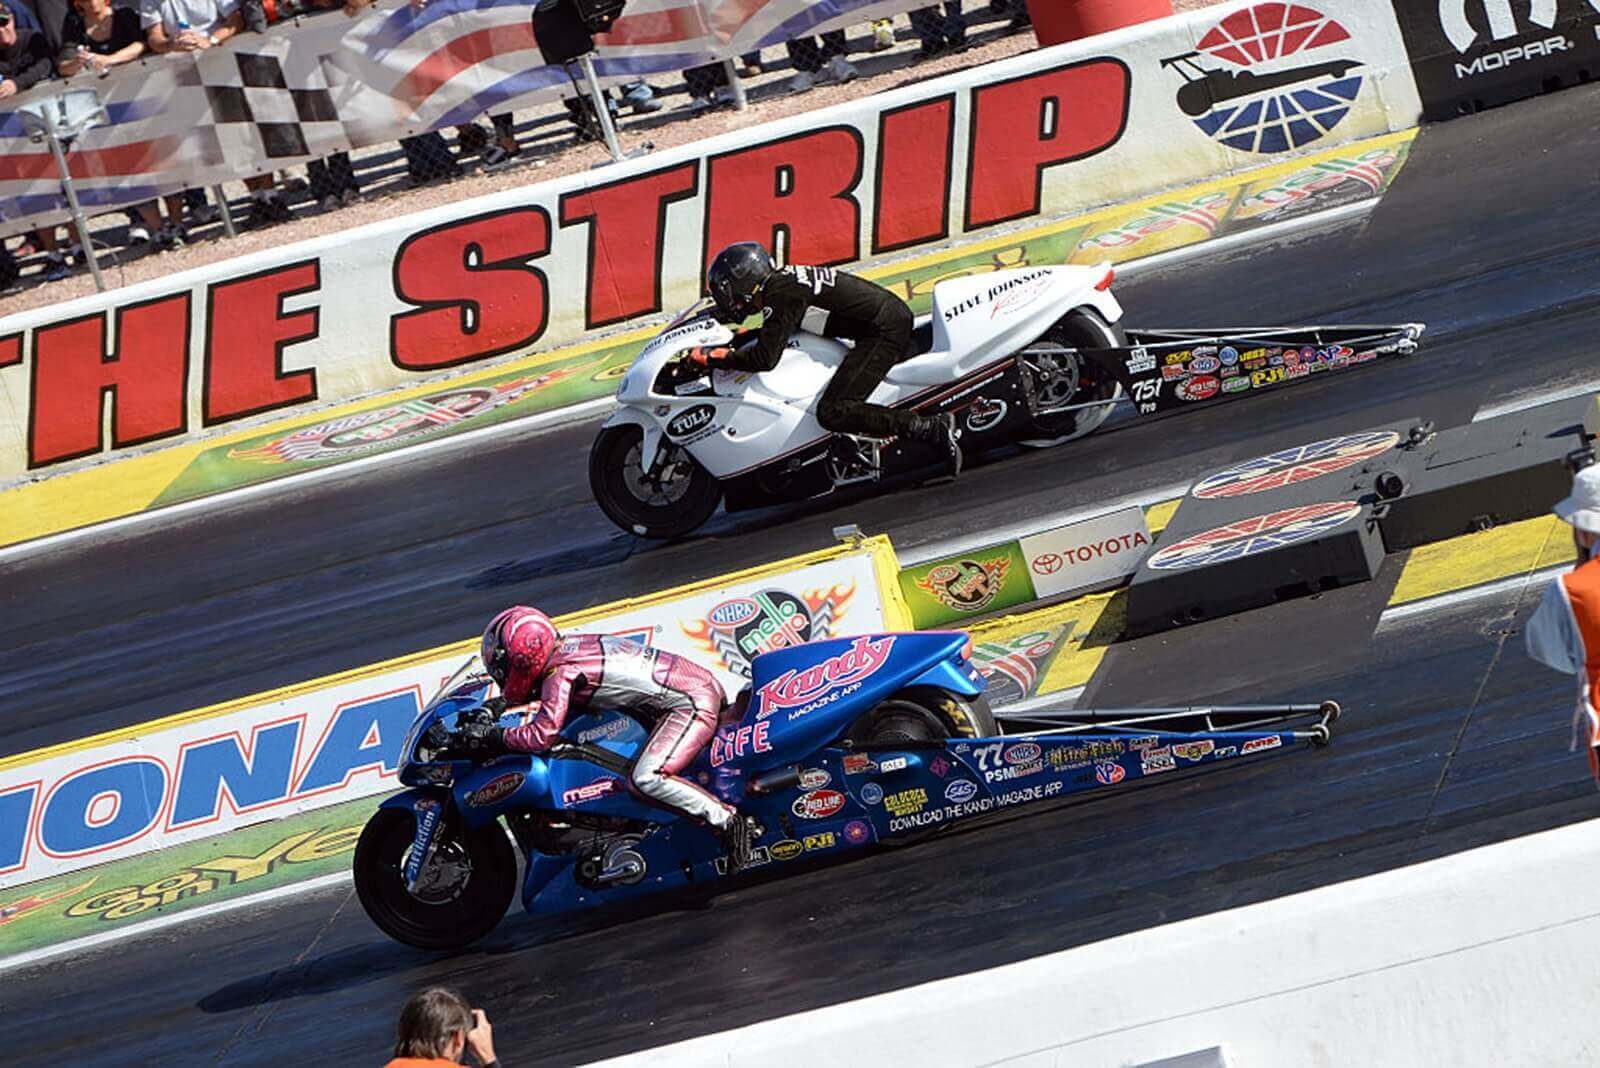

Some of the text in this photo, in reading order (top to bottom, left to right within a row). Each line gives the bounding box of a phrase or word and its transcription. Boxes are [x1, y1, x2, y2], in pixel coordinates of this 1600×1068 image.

[1454, 35, 1568, 79] MOPAR
[0, 56, 1131, 468] HE STRIP
[945, 294, 981, 322] STEVE
[987, 269, 1053, 301] JOHNSON
[1132, 378, 1162, 402] 751
[672, 407, 711, 434] TULL
[1064, 531, 1148, 565] TOYOTA
[713, 603, 754, 623] NHRA
[757, 636, 897, 716] Kandy
[788, 691, 841, 721] MAGAZINE
[840, 682, 863, 698] APP
[973, 743, 1004, 771] 77
[985, 766, 1016, 784] PSM
[889, 781, 1064, 832] DOWNLOAD THE KANDY MAGAZINE APP
